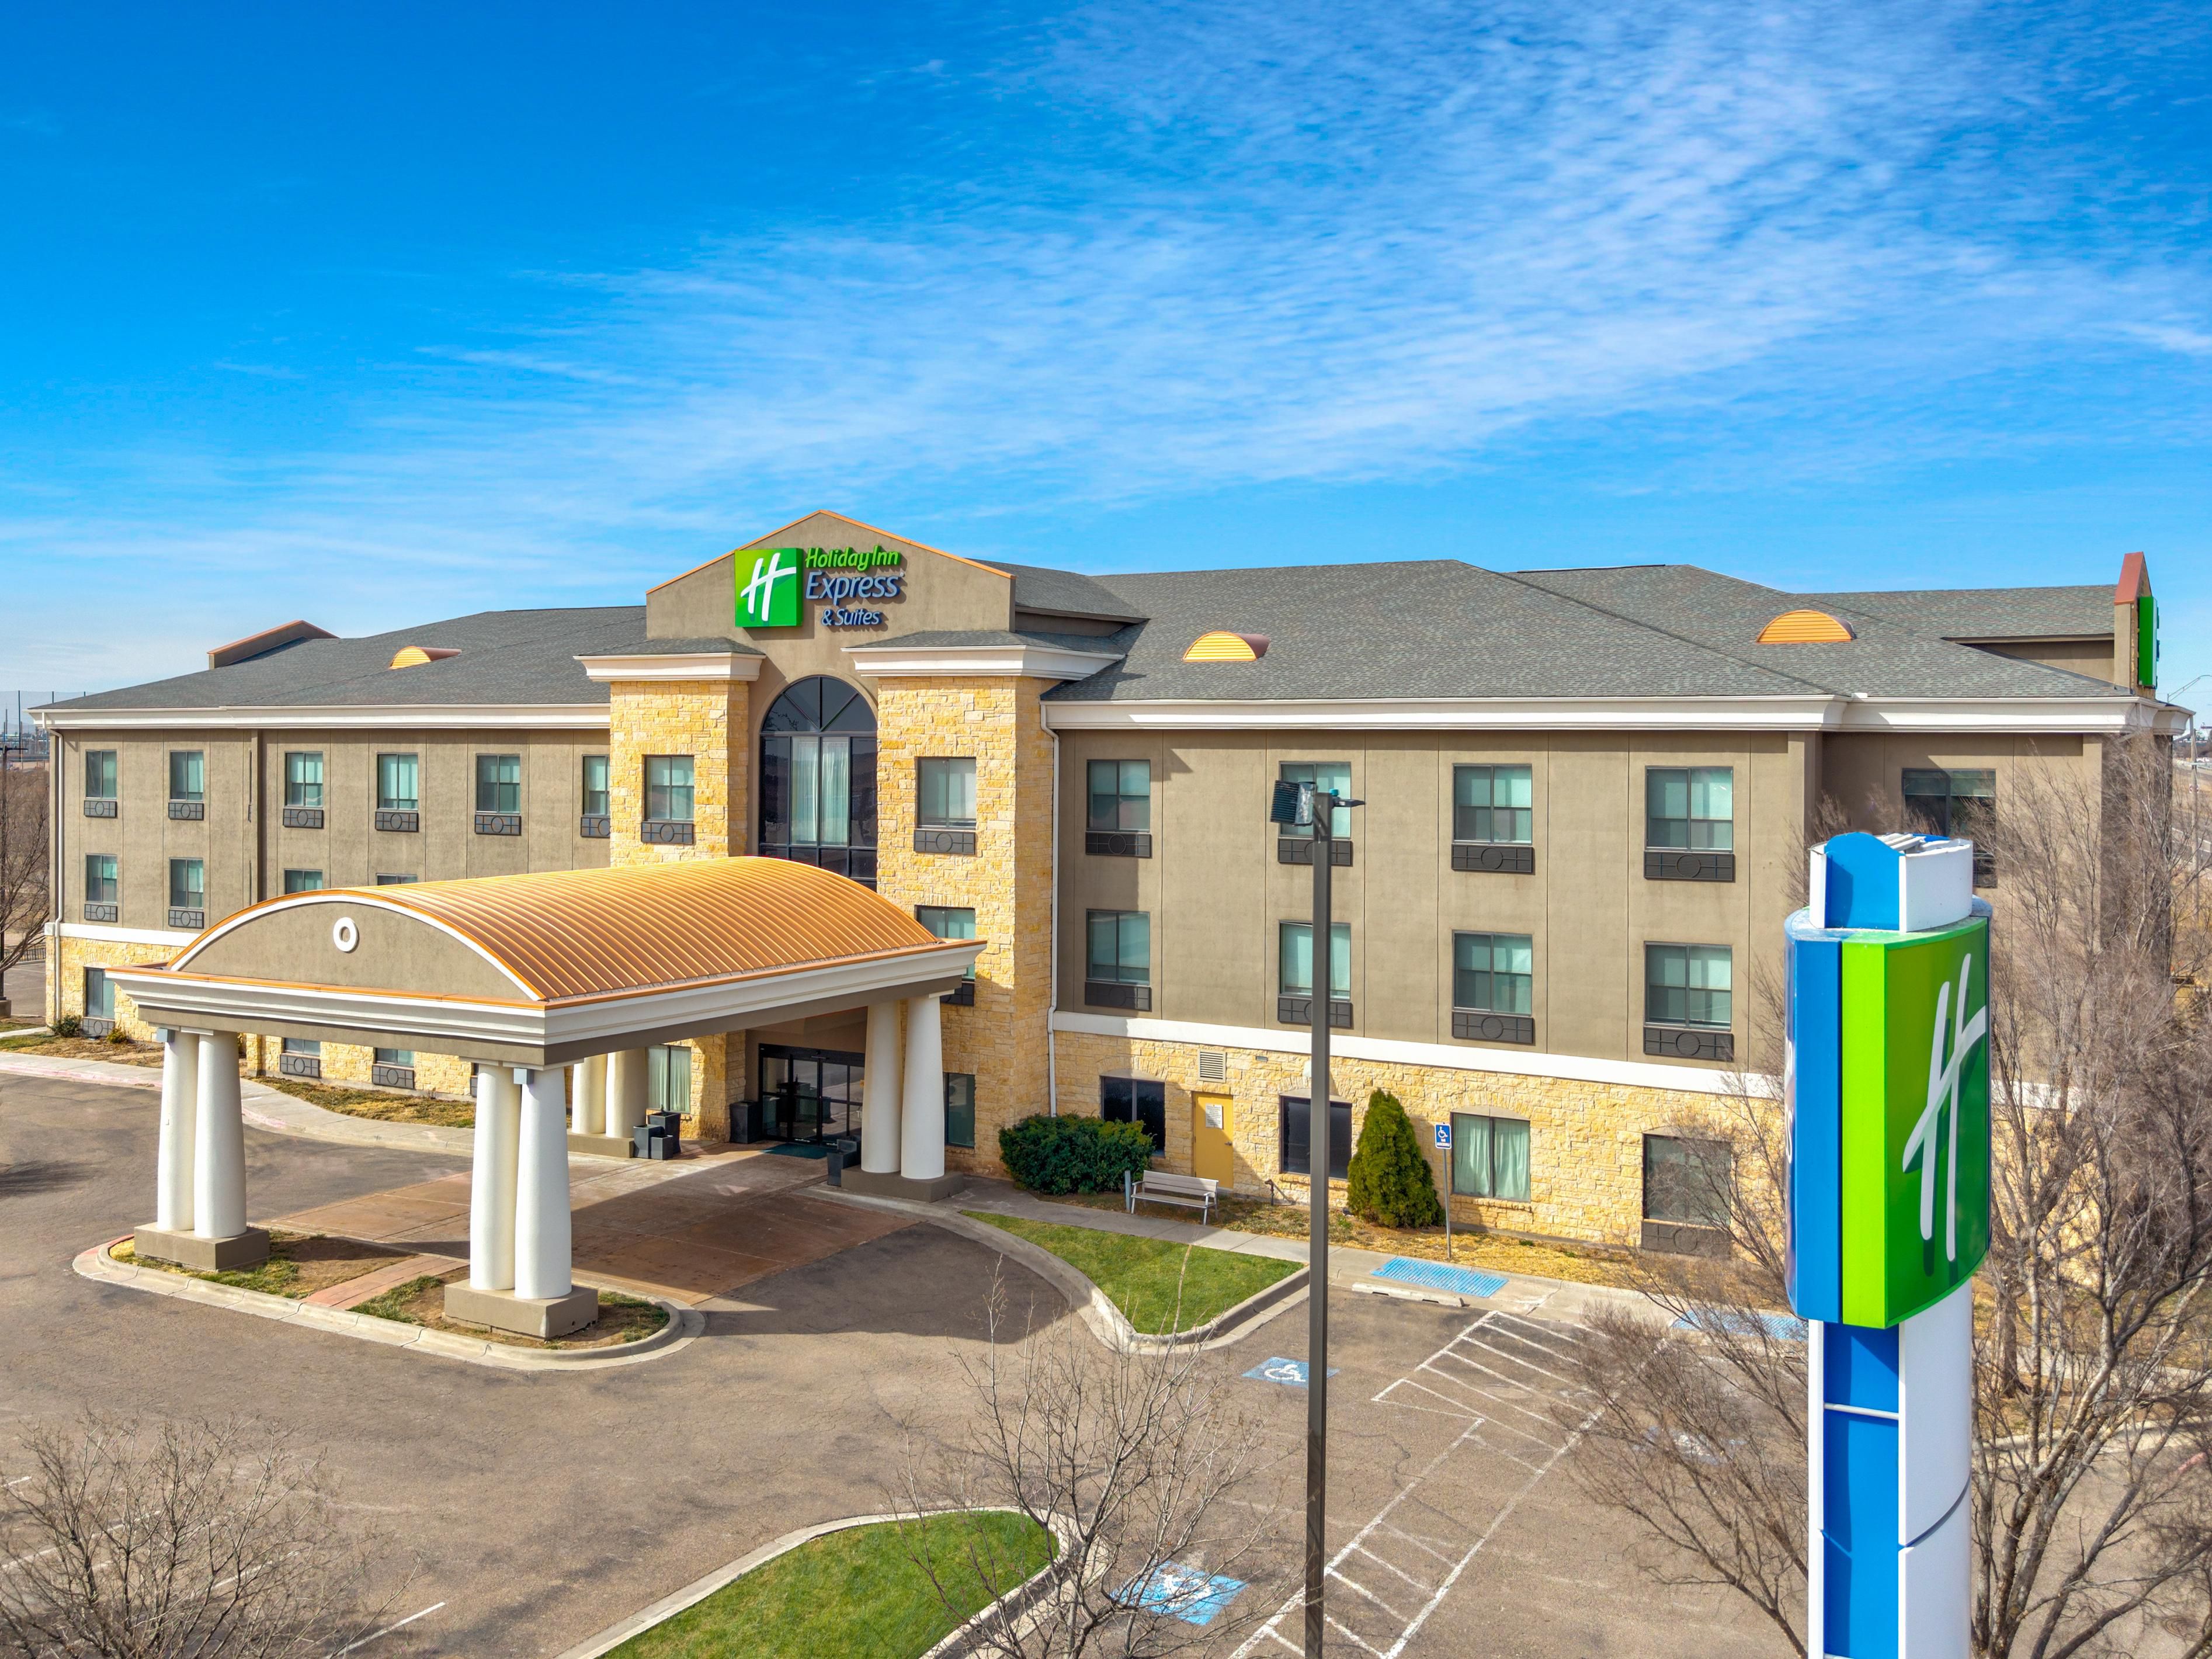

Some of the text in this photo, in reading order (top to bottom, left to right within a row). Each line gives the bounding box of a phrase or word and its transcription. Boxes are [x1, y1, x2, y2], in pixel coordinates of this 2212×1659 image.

[805, 544, 901, 572] Holiday Inn
[805, 571, 901, 606] Express
[821, 608, 881, 626] & Suites
